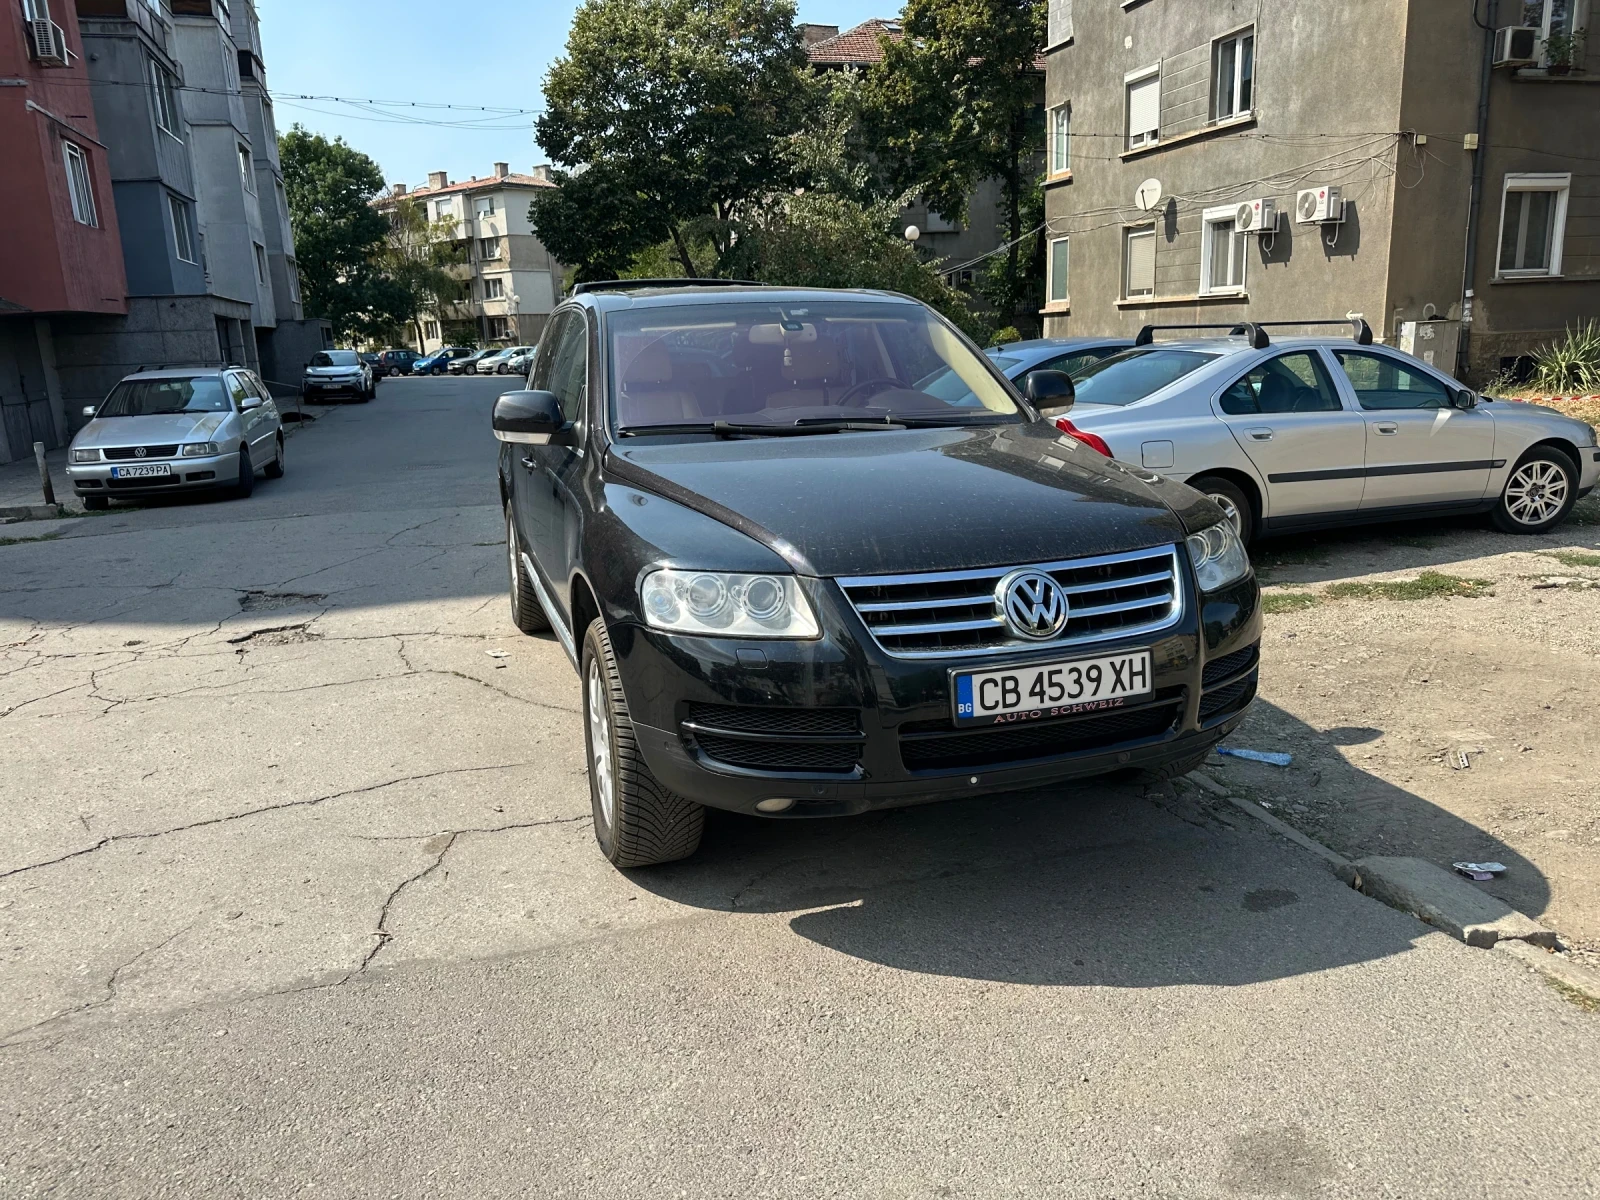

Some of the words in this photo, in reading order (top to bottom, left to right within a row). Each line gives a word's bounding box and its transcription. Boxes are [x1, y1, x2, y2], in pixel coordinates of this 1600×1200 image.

[119, 468, 132, 477] CA
[133, 466, 155, 476] 7239
[156, 465, 169, 475] PA
[1006, 573, 1067, 635] VW
[979, 676, 1021, 711] CB
[1029, 664, 1103, 704] 4539
[1109, 656, 1147, 694] XH
[958, 703, 972, 714] BG
[993, 710, 1042, 723] AUTO
[1050, 697, 1124, 716] SCHWEIZ
